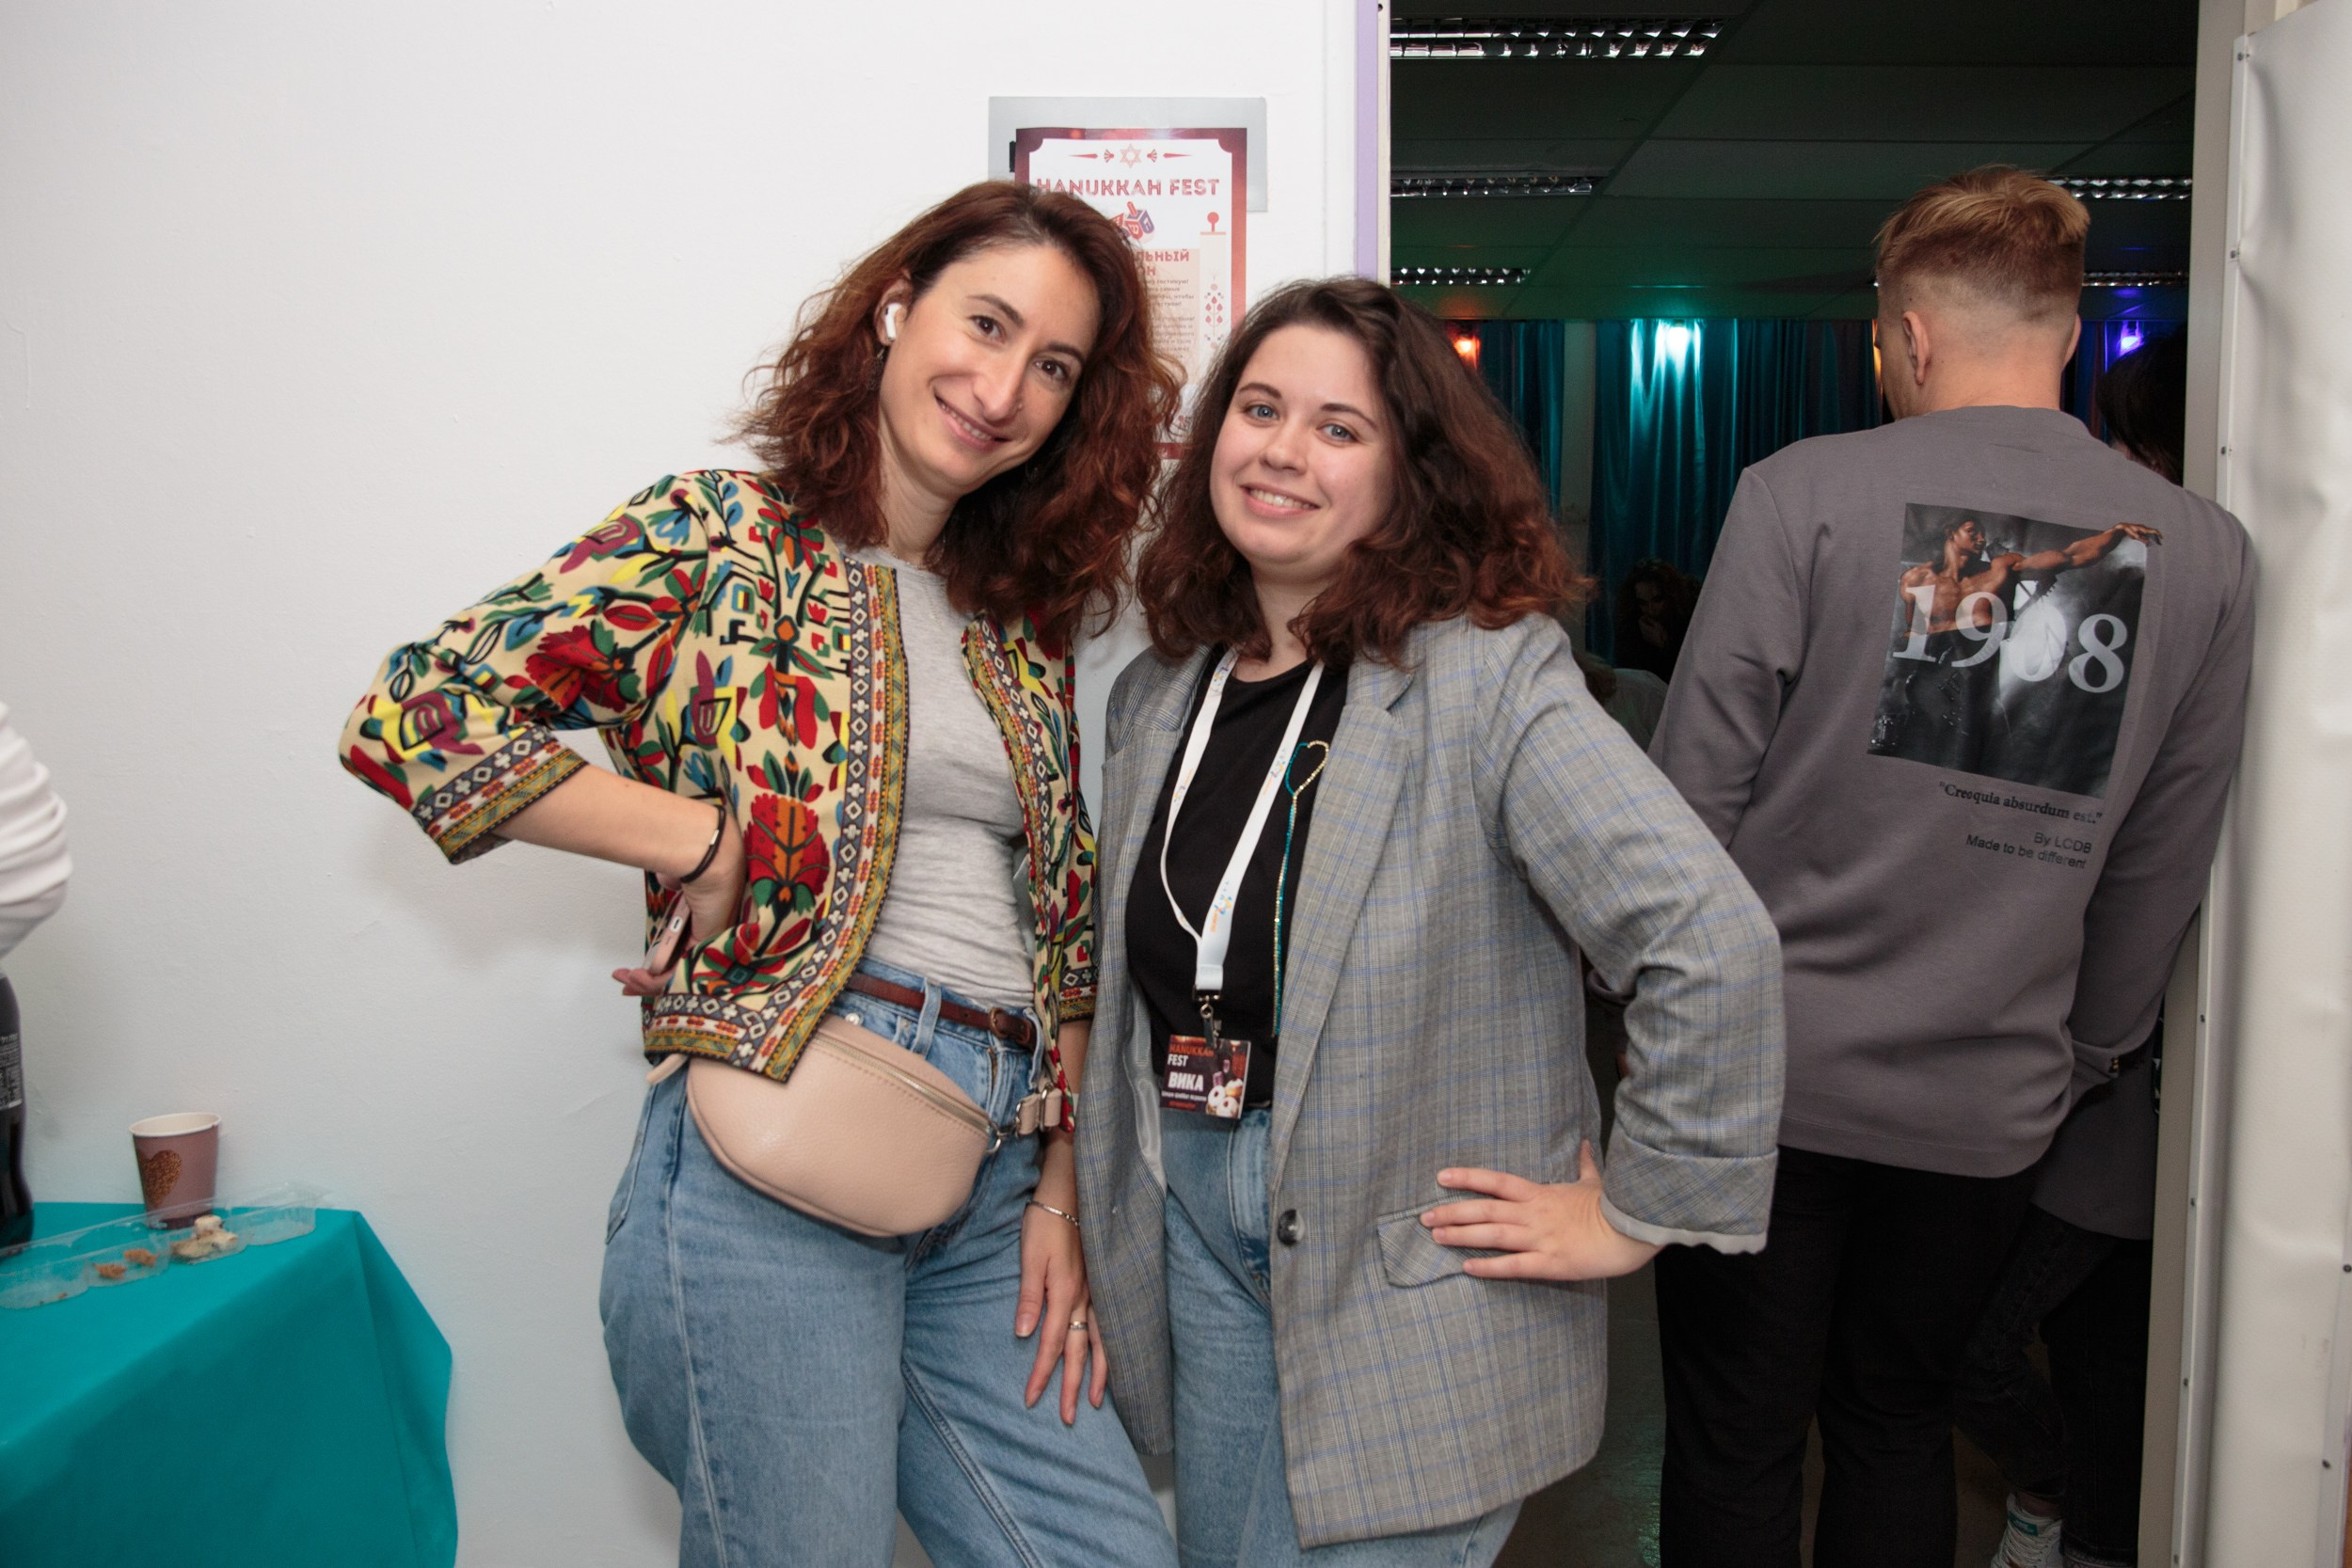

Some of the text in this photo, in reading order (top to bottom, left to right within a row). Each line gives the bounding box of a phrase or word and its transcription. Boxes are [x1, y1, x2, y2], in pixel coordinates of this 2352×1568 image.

[1037, 179, 1220, 197] HANUKKAH FEST
[1893, 583, 2128, 693] 1908
[2003, 796, 2070, 819] absurdum
[1965, 833, 2087, 870] Made to be different
[2034, 832, 2093, 854] By LCDB
[1167, 1053, 1189, 1067] FEST
[1168, 1071, 1204, 1092] ВИКА
